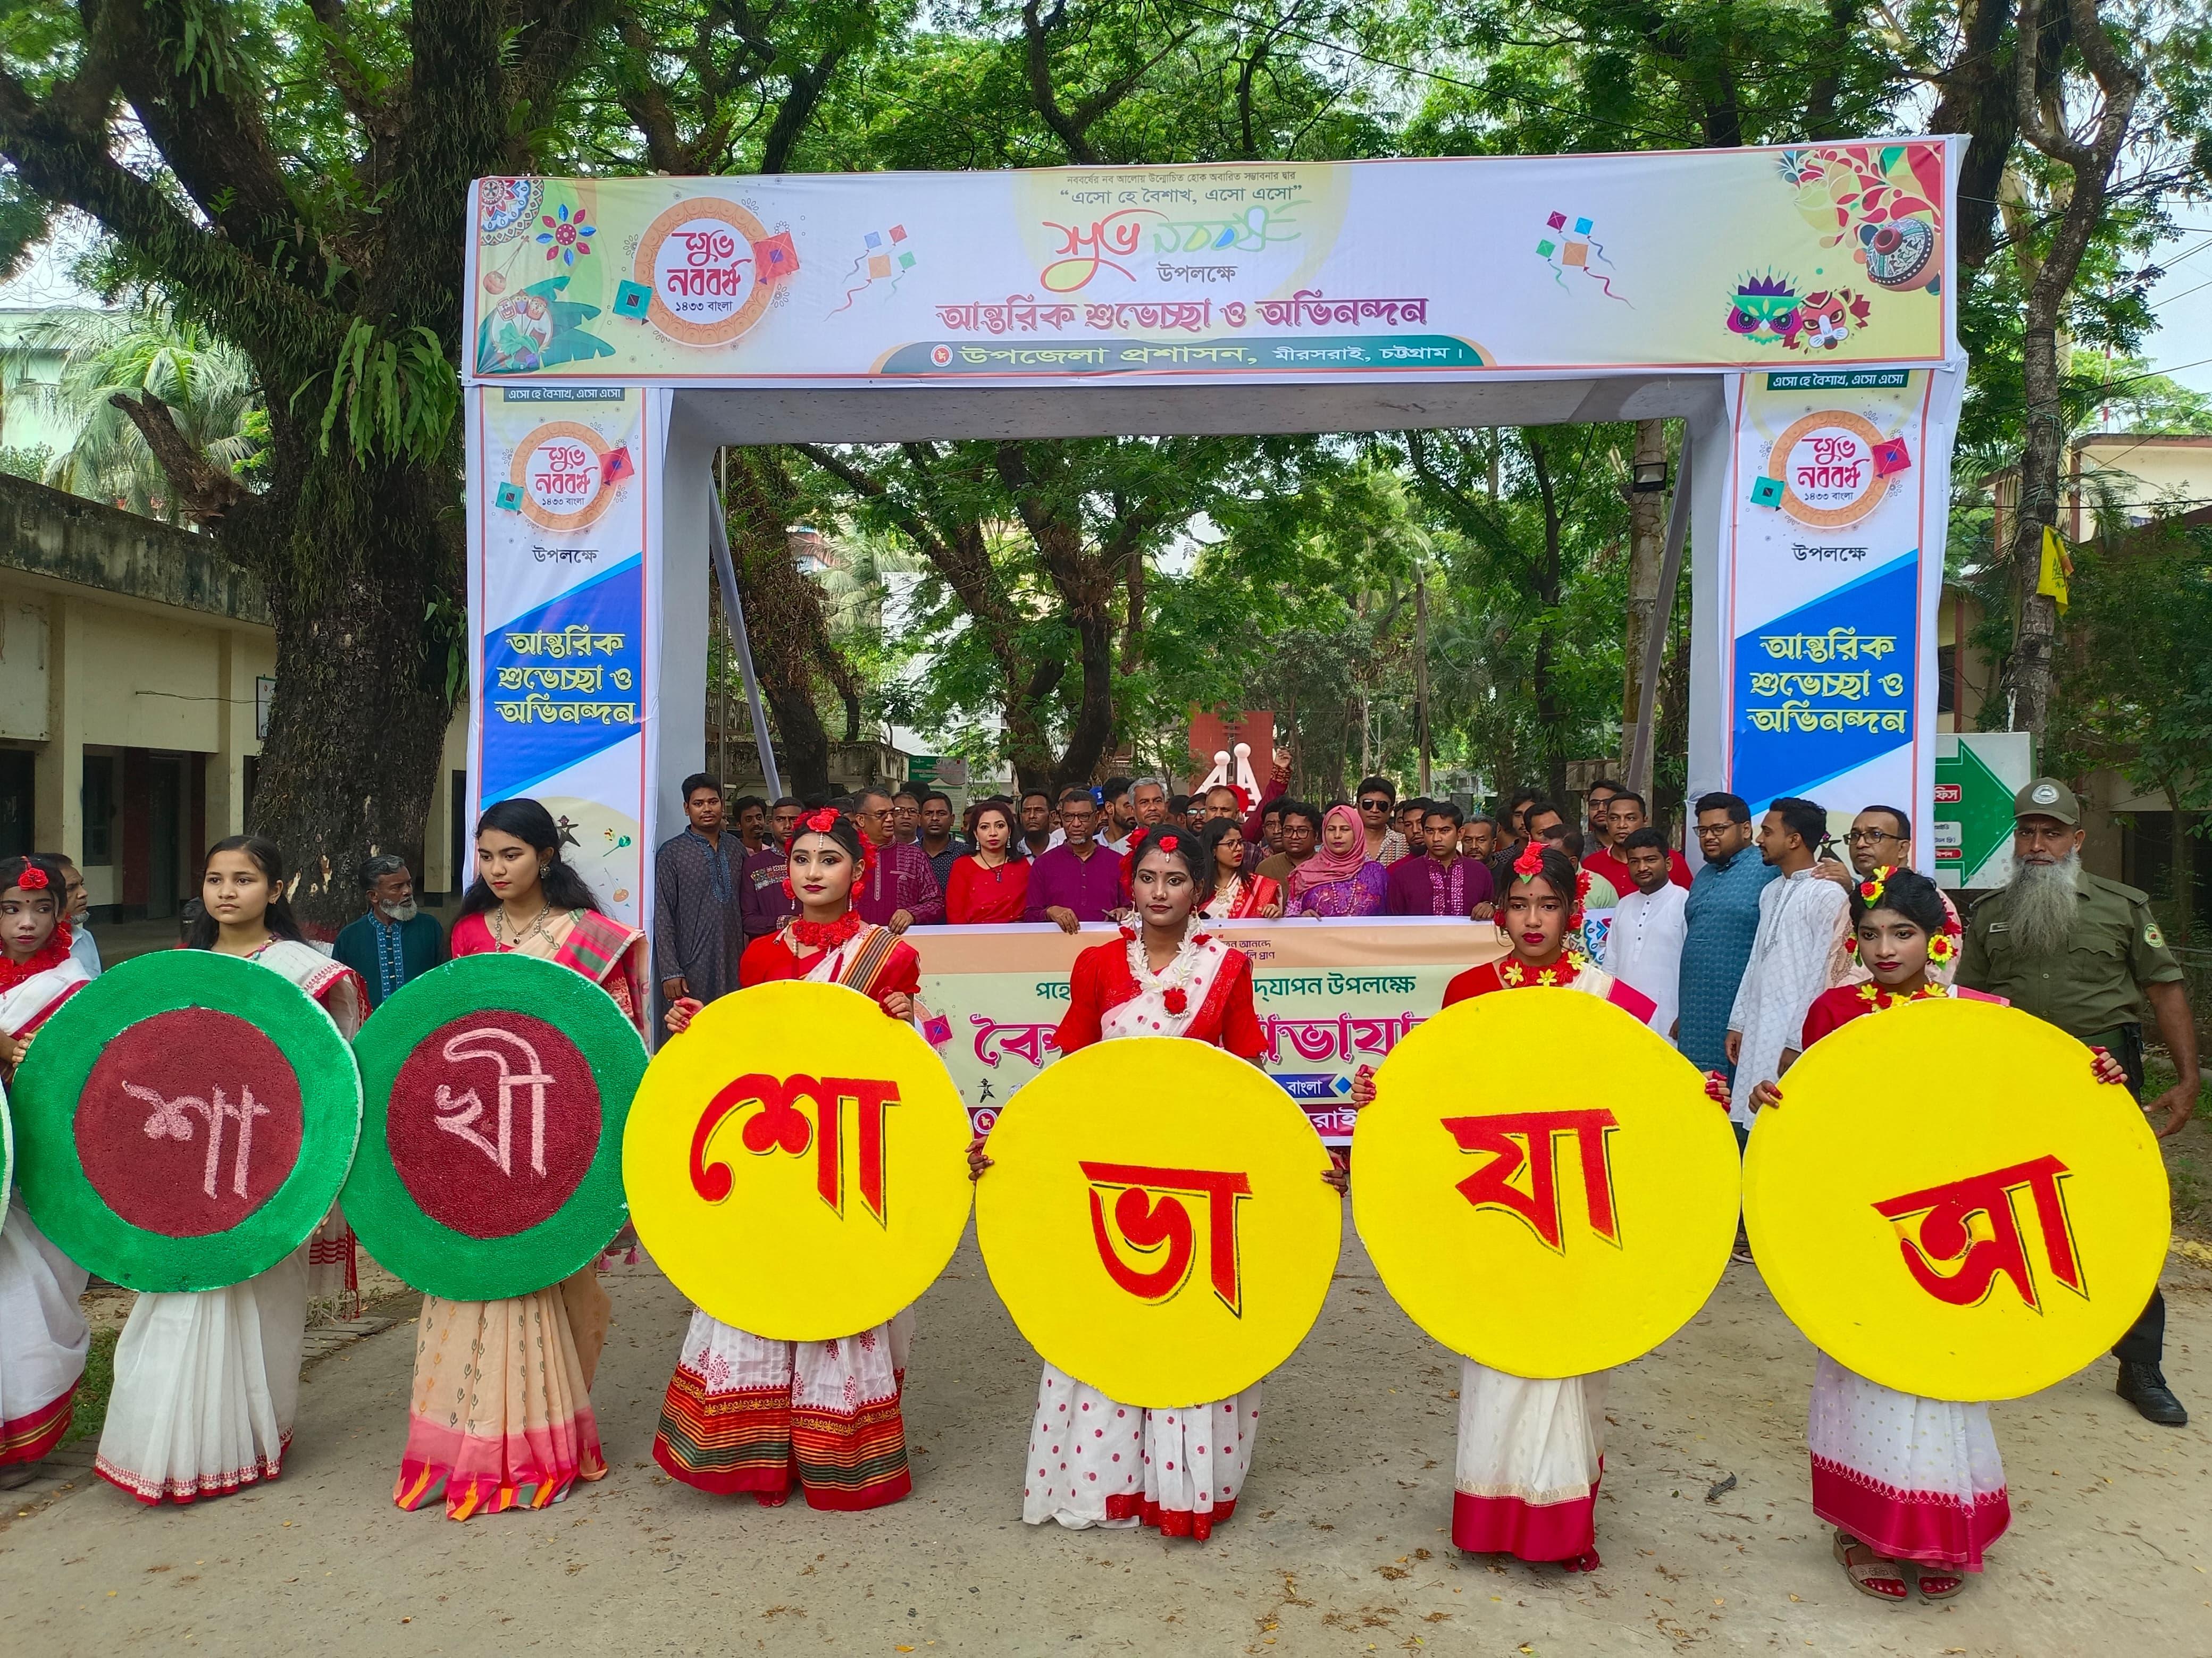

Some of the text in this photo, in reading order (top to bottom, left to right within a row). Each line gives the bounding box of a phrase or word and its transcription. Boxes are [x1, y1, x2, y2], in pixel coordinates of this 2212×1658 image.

[1067, 173, 1099, 184] নববর্ষের
[1117, 174, 1146, 183] আলোয়
[1149, 172, 1184, 183] উন্মোচিত
[1187, 174, 1207, 182] হোক
[1209, 171, 1242, 182] অবারিত
[1244, 171, 1279, 181] সম্ভাবনার
[1282, 171, 1296, 180] দ্বার
[1119, 191, 1138, 205] হে
[1141, 187, 1197, 205] বৈশাখ,
[1205, 187, 1246, 201] এসো
[672, 230, 734, 266] শুভ
[1041, 209, 1170, 293] শুভ
[667, 259, 752, 296] নববর্ষ
[1156, 261, 1238, 284] উপলক্ষে
[676, 301, 733, 312] ১৪৩৩ বাংলা
[935, 289, 1429, 335] আন্তরিক শুভেচ্ছা ও অভিনন্দন
[958, 346, 1111, 365] উপজেলা
[1121, 347, 1258, 365] প্রশাসন,
[1272, 346, 1371, 362] মীরসরাই,
[509, 388, 621, 400] এসো হে বৈশাখ, এসো এসো
[1773, 373, 1904, 387] এসো হে বৈশাখ, এসো এসো
[538, 445, 585, 472] শুভ
[1802, 435, 1856, 465] শুভ
[535, 466, 599, 494] নববর্ষ
[1797, 459, 1870, 489] নববর্ষ
[1804, 492, 1854, 501] ১৪৩৩ বাংলা
[532, 545, 599, 564] উপলক্ষে
[1791, 543, 1869, 561] উপলক্ষে
[505, 624, 626, 659] আন্তরিক
[1759, 626, 1897, 663] আন্তরিক
[496, 664, 633, 694] শুভেচ্ছা ও
[1749, 668, 1904, 701] শুভেচ্ছা ও
[494, 693, 636, 725] অভিনন্দন
[1746, 700, 1907, 734] অভিনন্দন
[1259, 952, 1275, 960] প্রাণ
[1036, 982, 1071, 1000] পহে
[1327, 972, 1417, 995] উপলক্ষে
[435, 1028, 555, 1176] খী
[1286, 1080, 1323, 1096] বাংলা
[122, 1080, 270, 1199] শা
[690, 1073, 901, 1229] শো
[1441, 1108, 1622, 1256] যা
[1078, 1161, 1253, 1319] ভা
